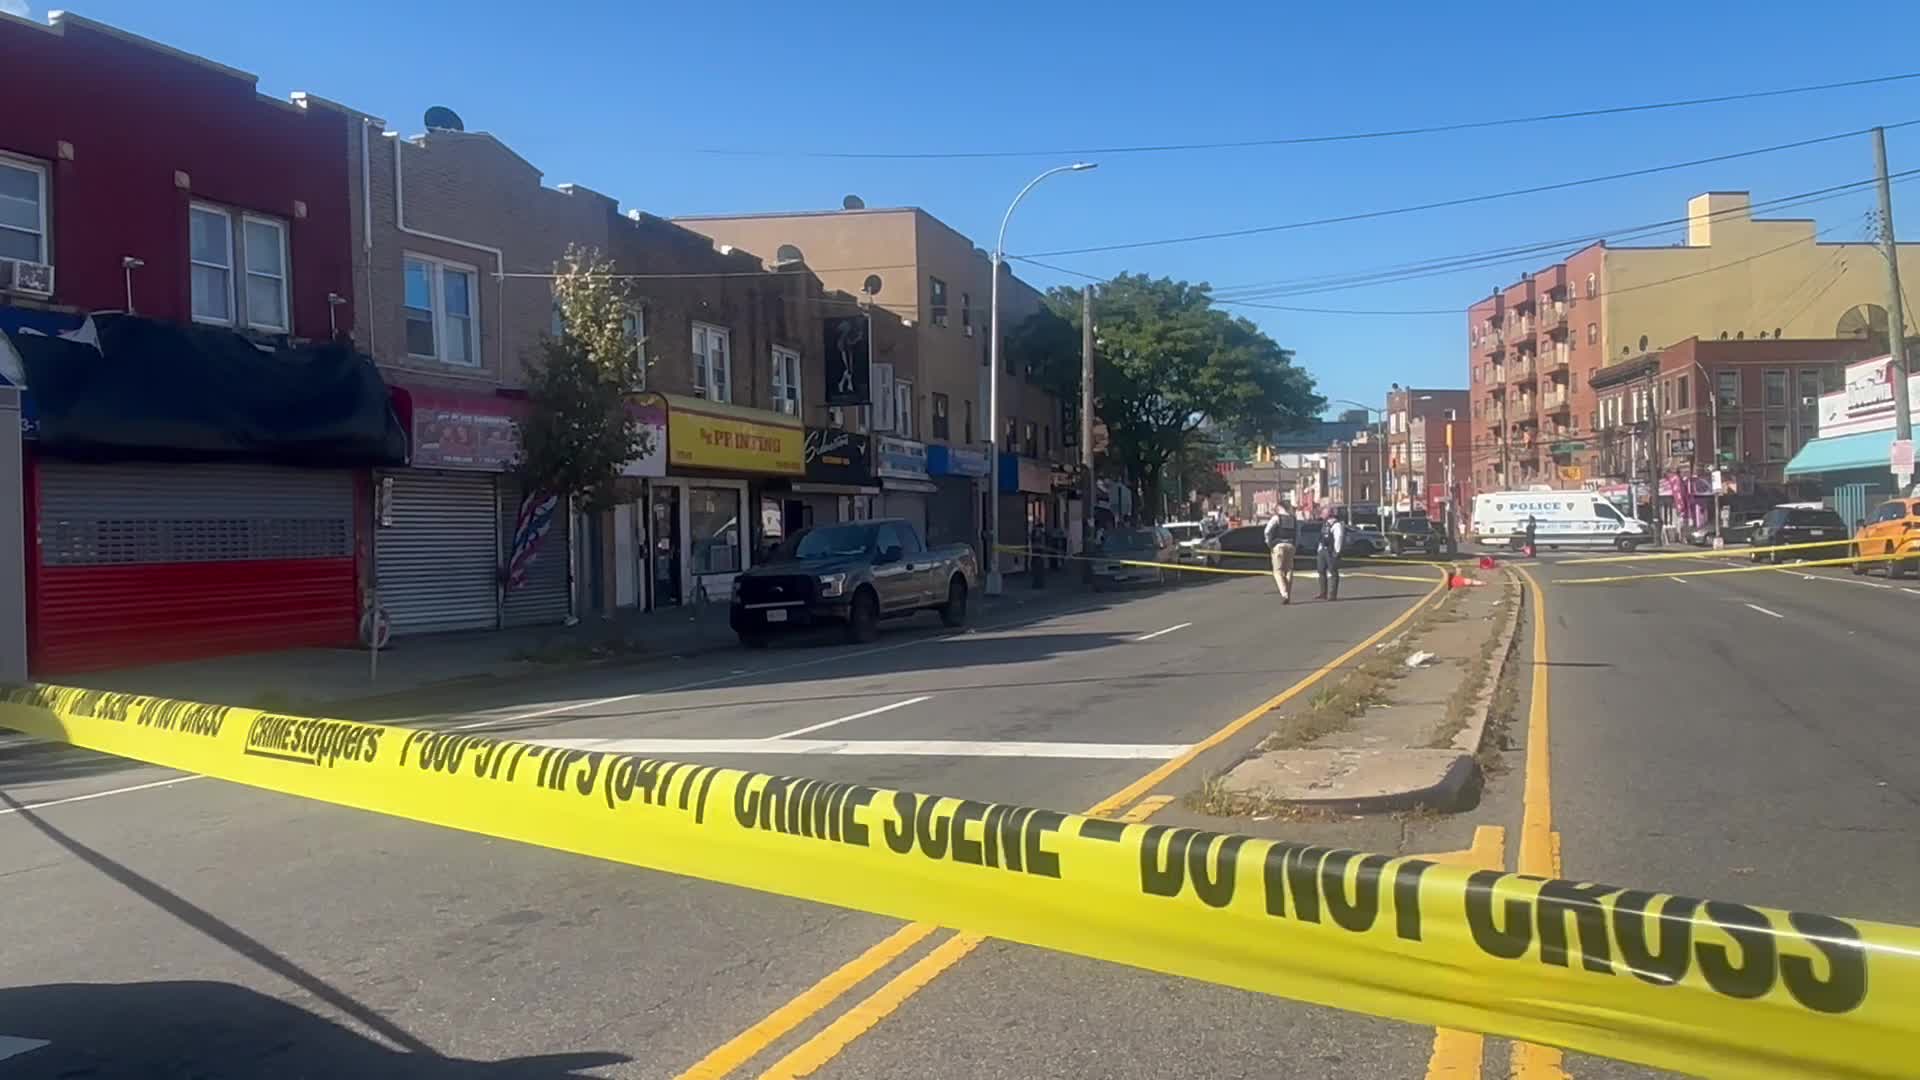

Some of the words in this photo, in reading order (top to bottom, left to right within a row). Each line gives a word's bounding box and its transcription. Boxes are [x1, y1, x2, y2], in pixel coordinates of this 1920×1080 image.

[1509, 502, 1561, 511] POLICE
[734, 771, 878, 848] CRIME
[884, 791, 1069, 879] SCENE
[1140, 824, 1250, 908] DO
[1264, 841, 1441, 942] NOT
[1465, 869, 1868, 1014] CROSS
